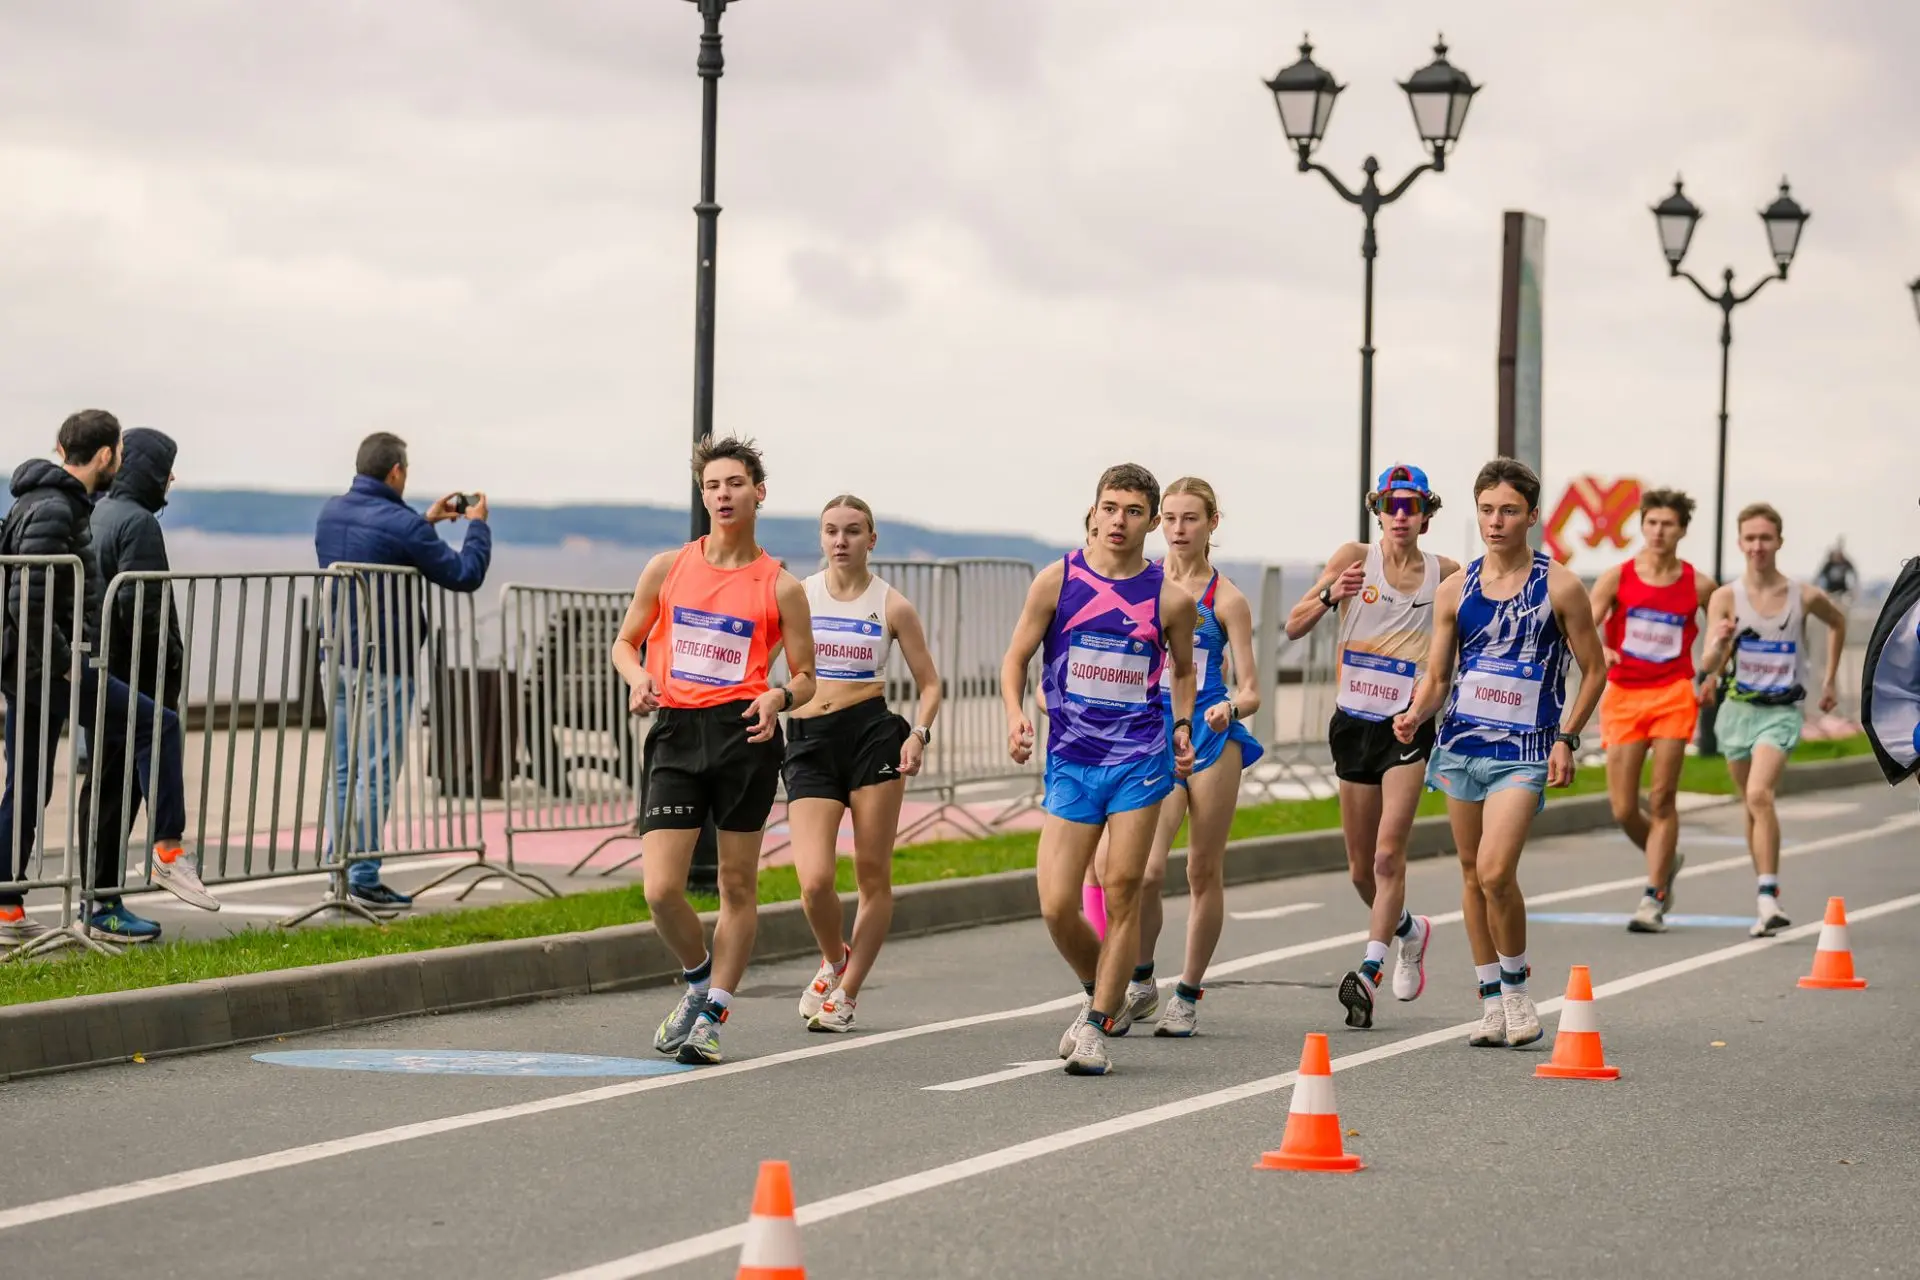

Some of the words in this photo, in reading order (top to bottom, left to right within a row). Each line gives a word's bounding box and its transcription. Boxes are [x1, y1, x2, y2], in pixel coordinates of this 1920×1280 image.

[675, 639, 742, 665] ПЕПЕЛЕНКОВ
[1072, 662, 1144, 686] ЗДОРОВИНИН
[1350, 679, 1399, 701] БАЛТАЧЕВ
[1474, 685, 1522, 706] КОРОБОВ
